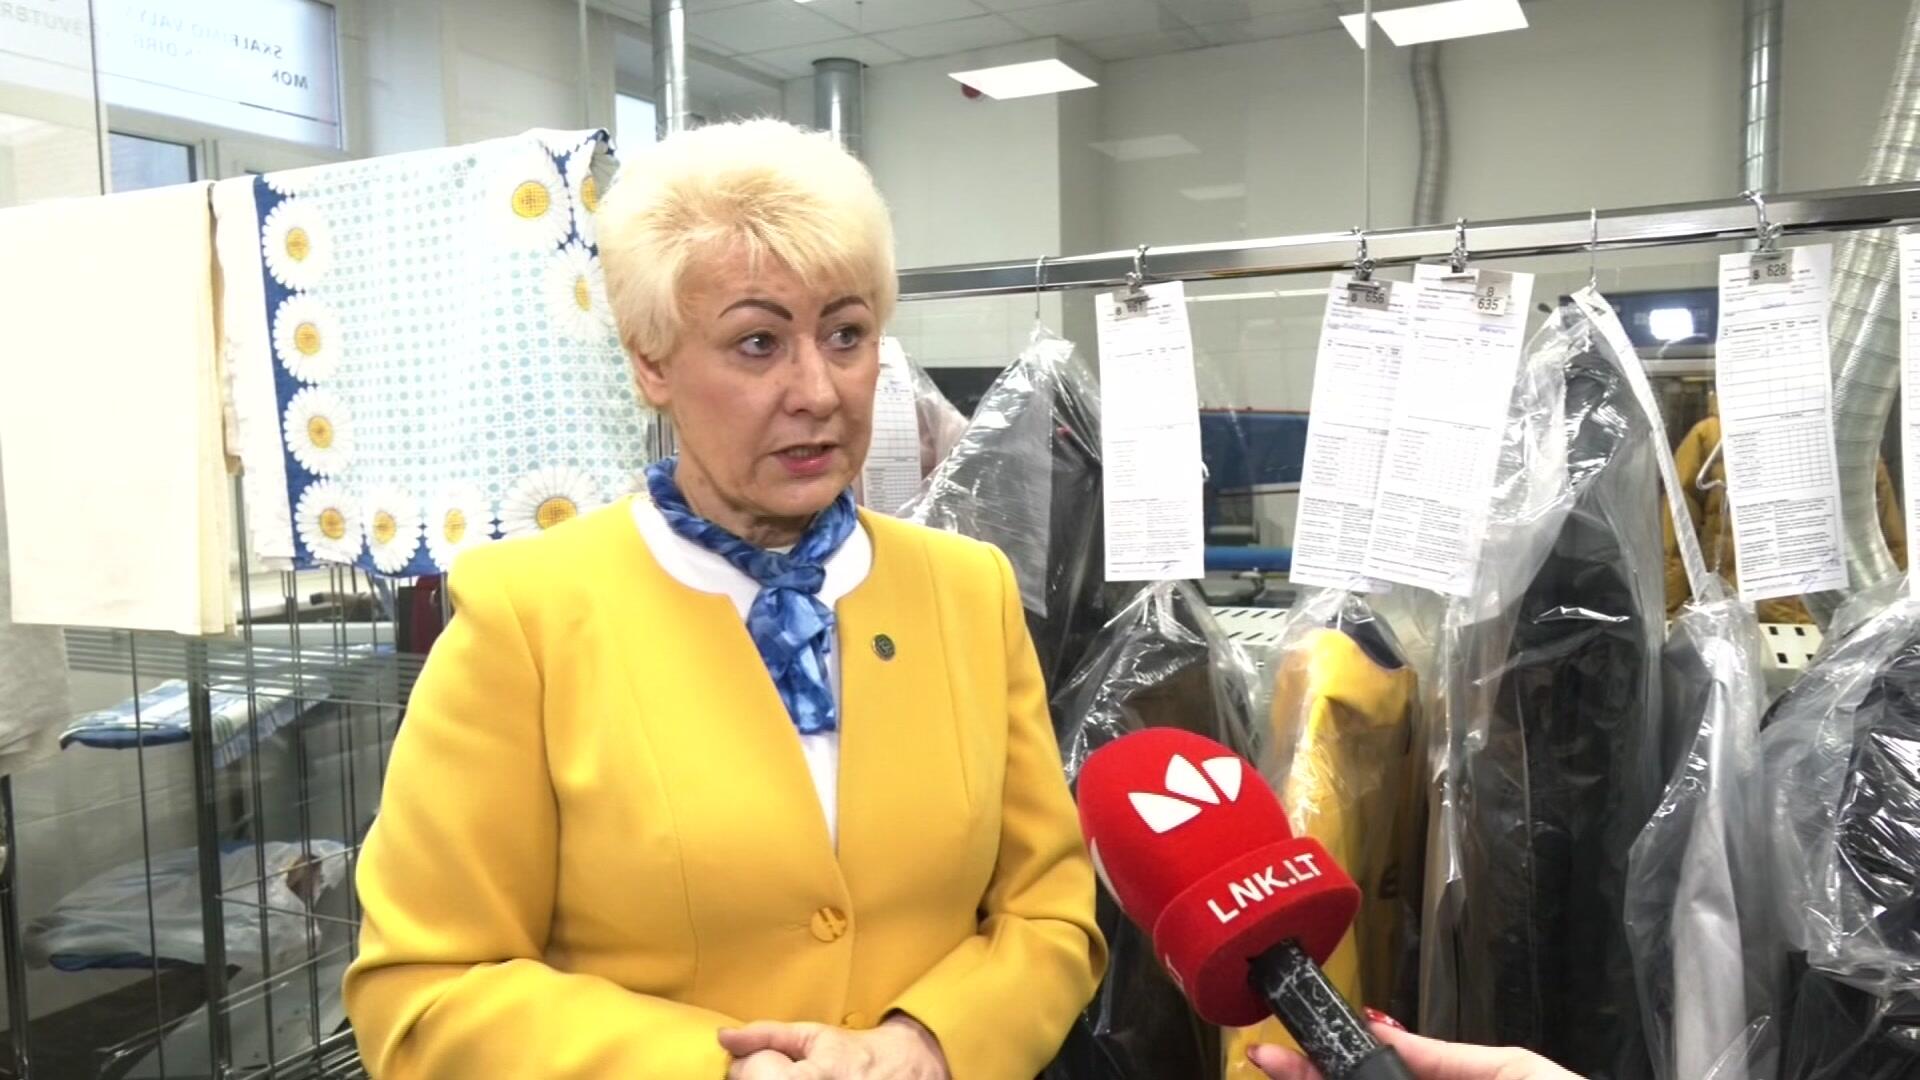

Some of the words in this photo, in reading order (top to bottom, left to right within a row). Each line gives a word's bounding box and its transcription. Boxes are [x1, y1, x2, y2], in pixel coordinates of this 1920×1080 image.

[1767, 262, 1787, 277] 628
[1366, 290, 1385, 304] 656
[1478, 297, 1498, 311] 635
[1207, 853, 1322, 924] LNK.LT
